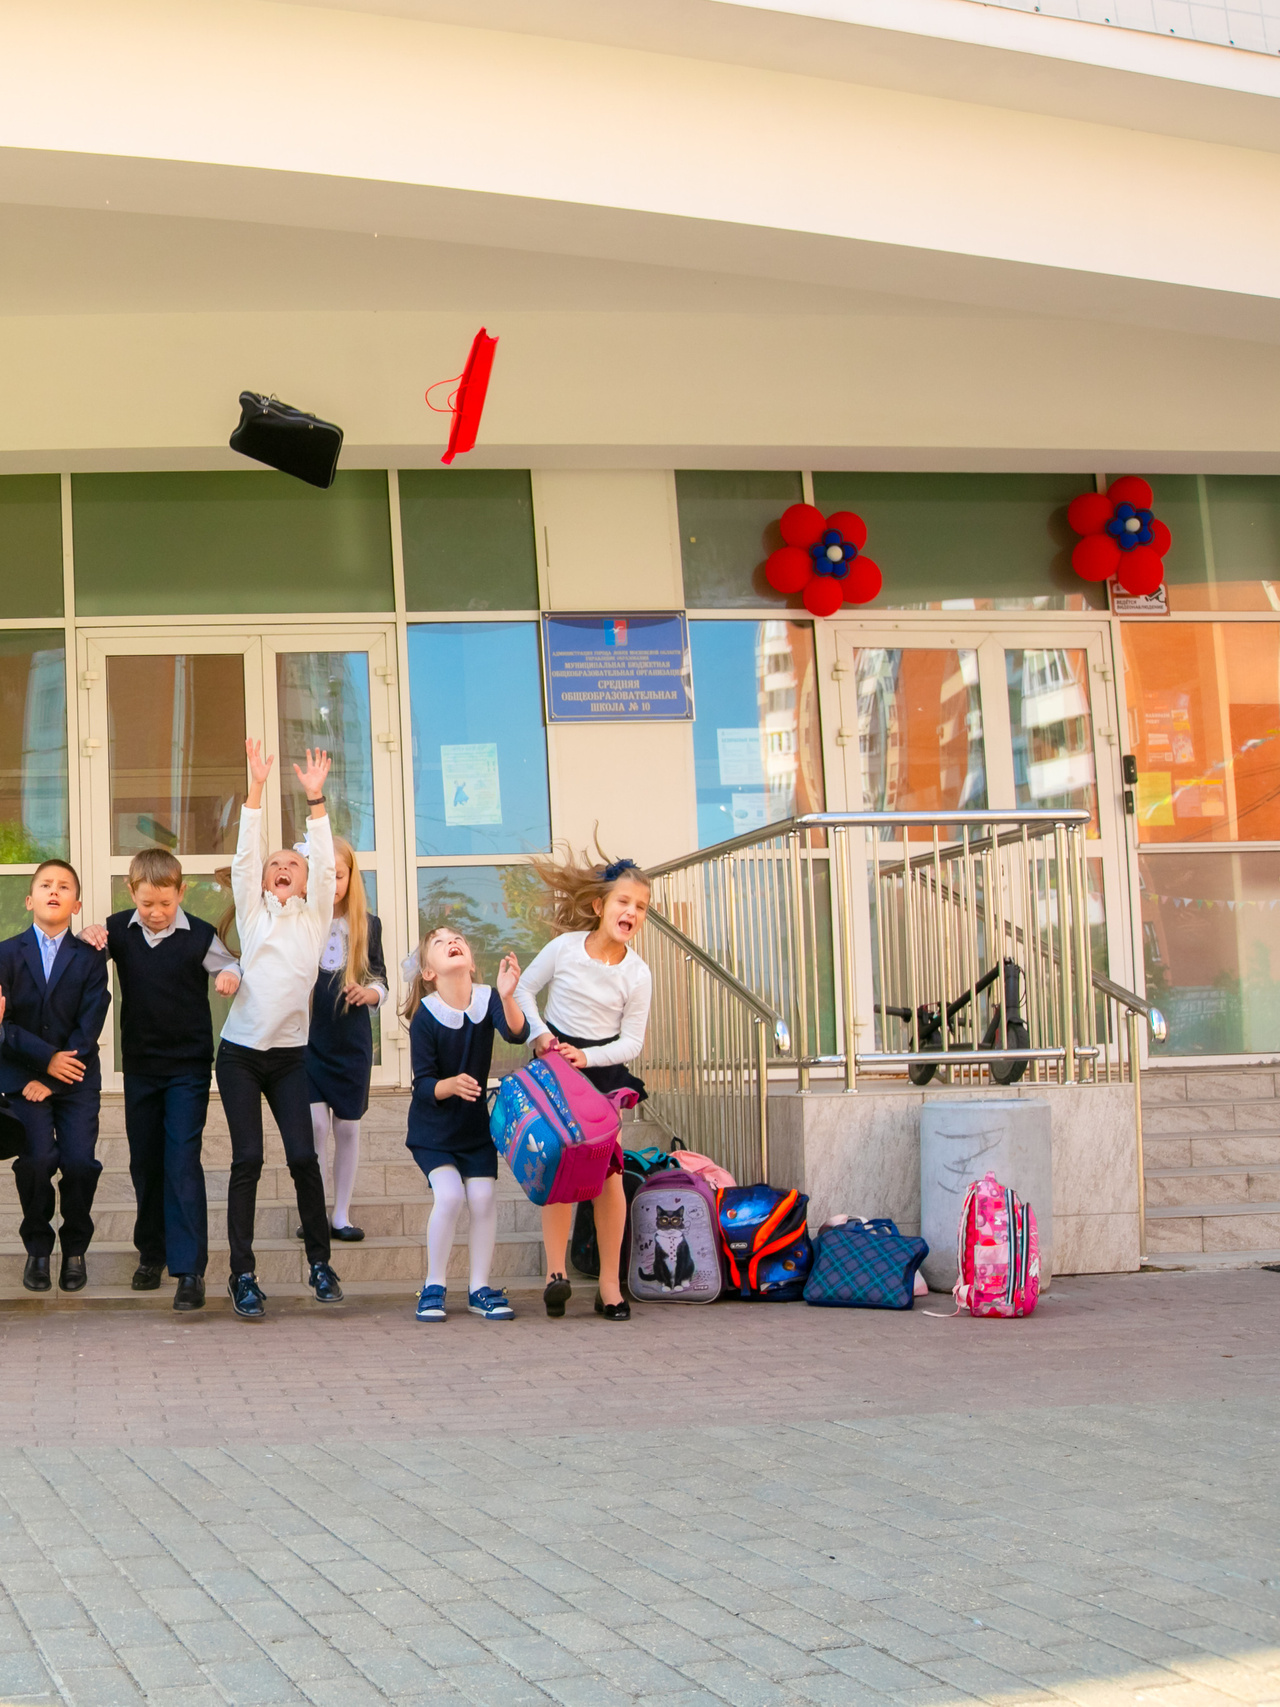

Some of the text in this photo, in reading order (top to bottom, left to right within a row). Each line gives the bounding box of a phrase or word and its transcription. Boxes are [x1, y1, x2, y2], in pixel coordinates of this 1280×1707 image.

[628, 661, 670, 669] БЮДЖЕТНАЯ
[636, 669, 683, 677] ОРГАНИЗАЦИ
[597, 680, 640, 690] СРЕДНЯЯ
[561, 691, 677, 702] ОБЩЕОБРАЗОВАТЕЛЬНАЯ
[590, 702, 651, 712] ШКОЛА № 10
[639, 1239, 653, 1251] CAT
